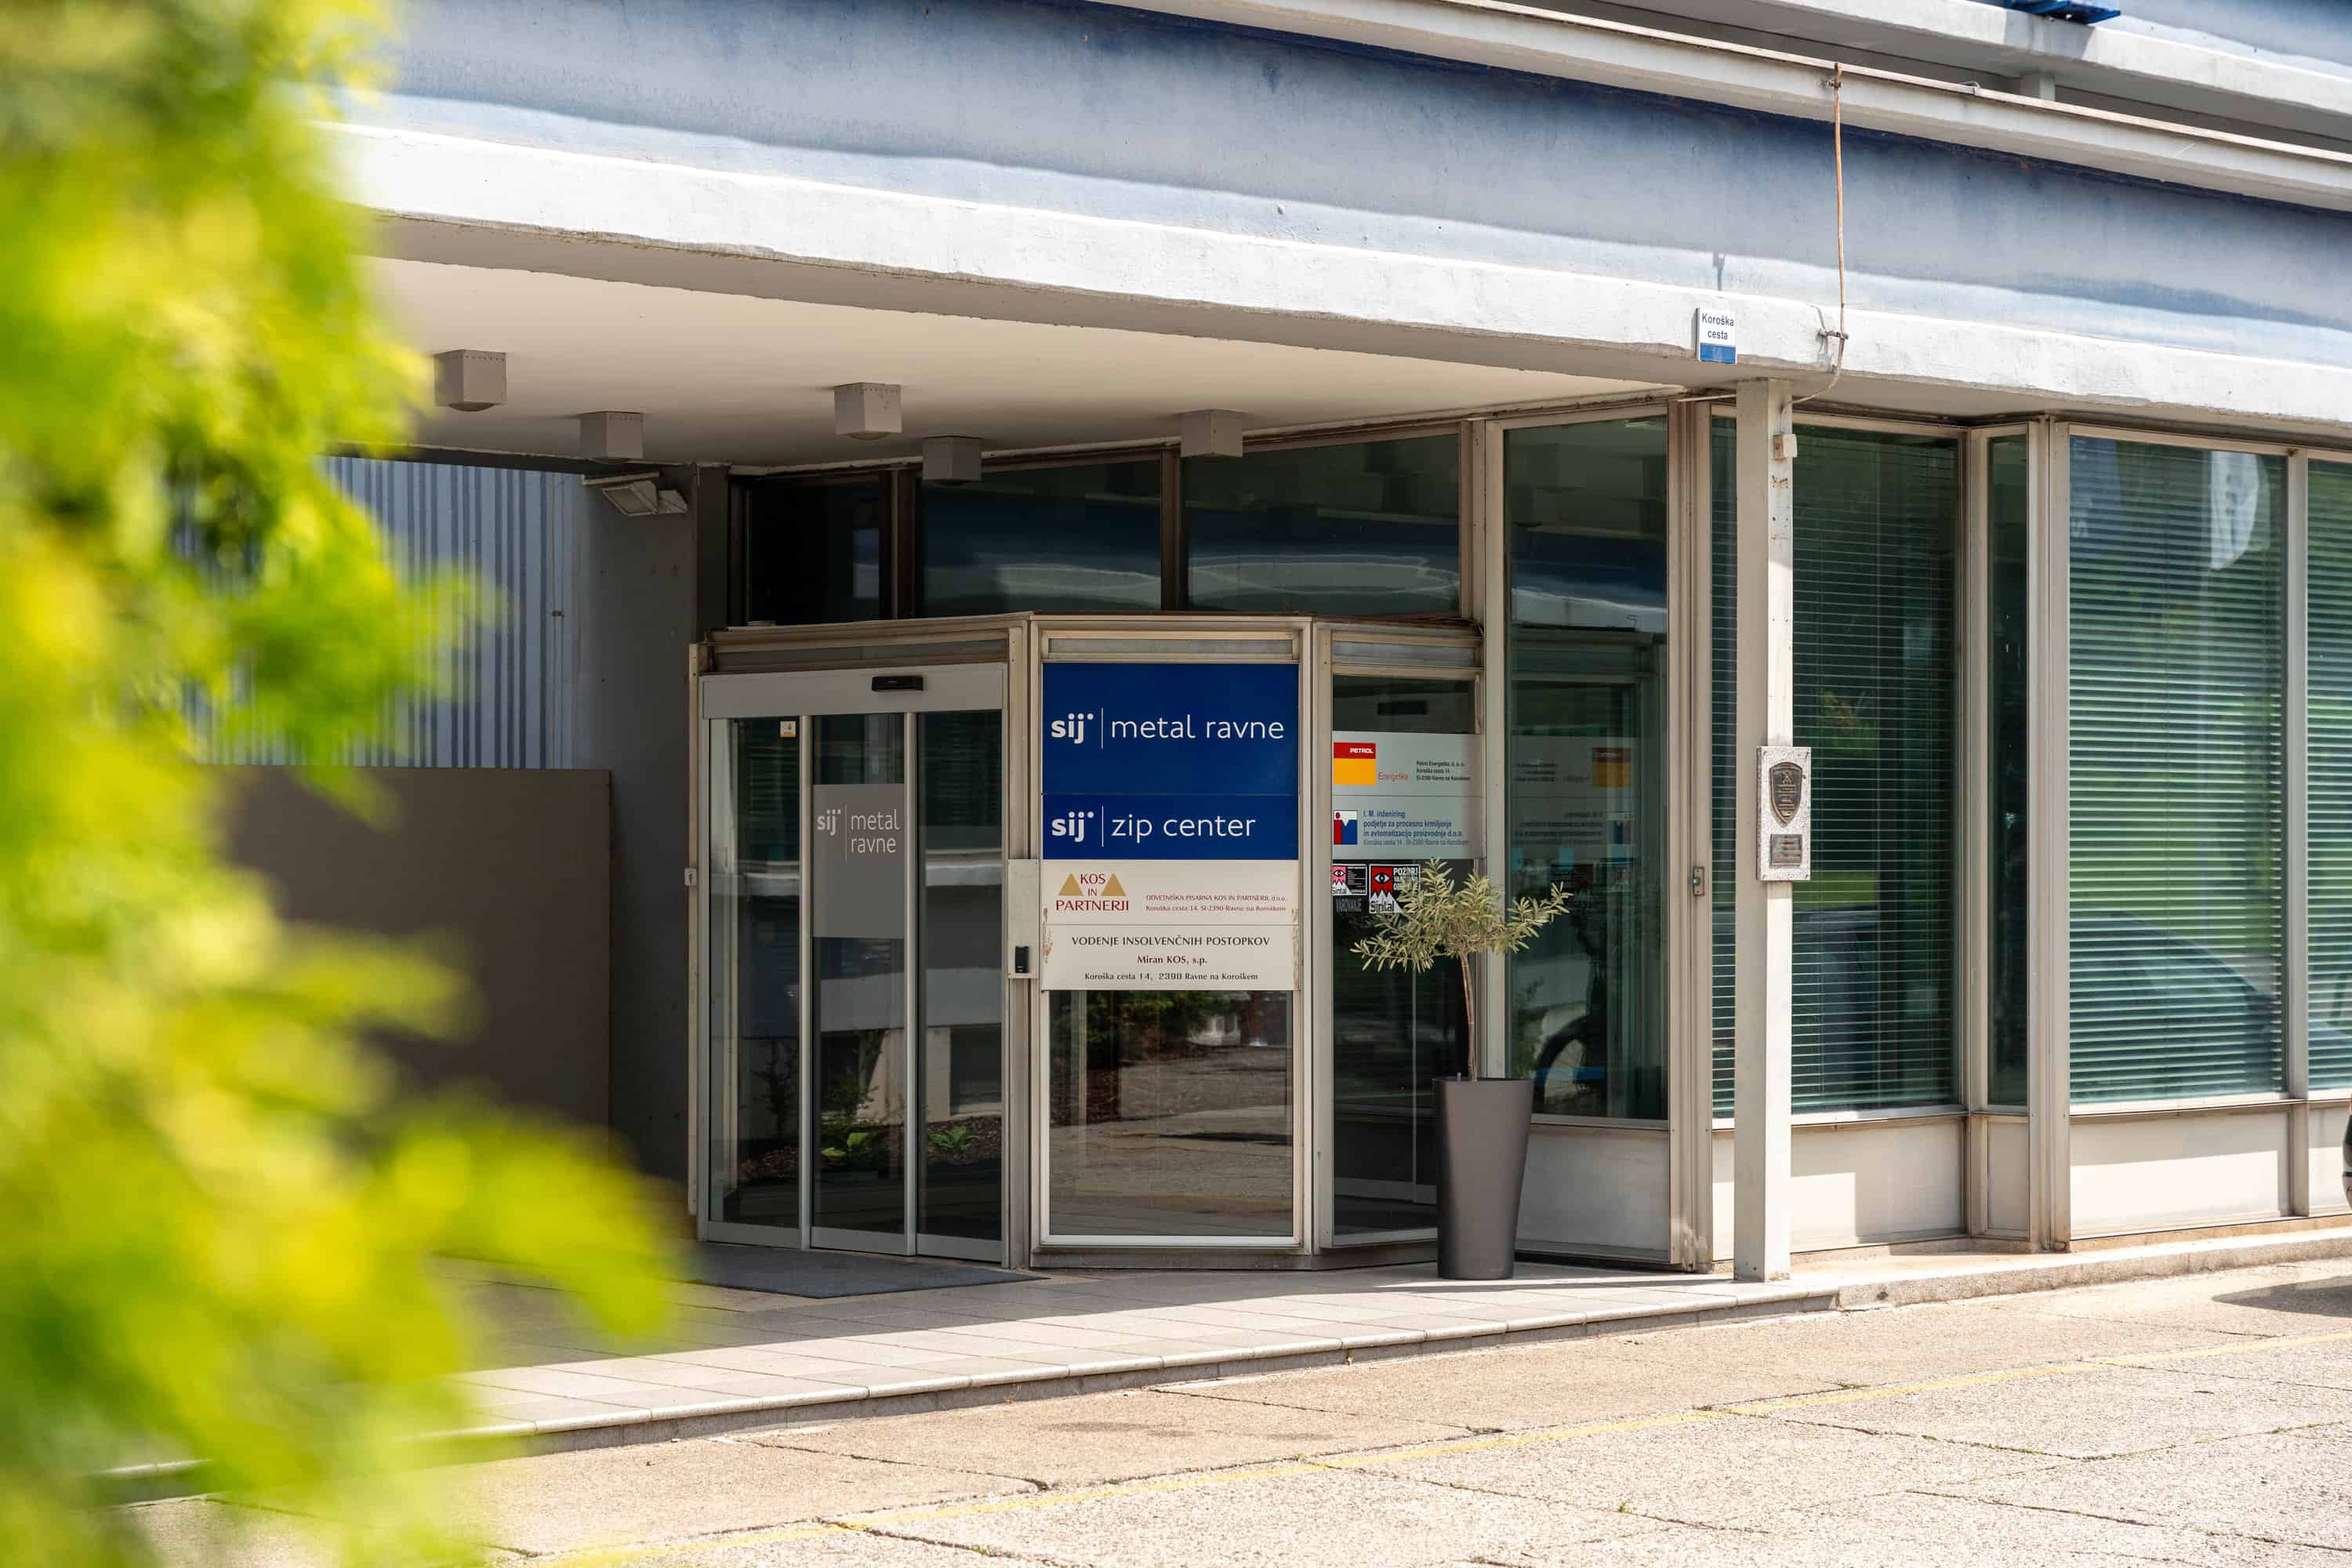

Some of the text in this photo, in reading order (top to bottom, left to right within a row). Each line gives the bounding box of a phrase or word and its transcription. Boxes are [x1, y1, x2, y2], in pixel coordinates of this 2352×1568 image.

[1702, 314, 1734, 326] Koroška
[1708, 330, 1728, 340] cesta
[1051, 713, 1284, 744] sij metal ravne
[1378, 772, 1409, 782] Energetika
[1377, 810, 1405, 818] inženiring
[817, 808, 901, 836] sij metal
[1051, 811, 1256, 844] sij zip center
[1363, 820, 1387, 829] podjetje
[1424, 820, 1452, 829] krmiljenje
[851, 837, 896, 854] ravne
[1080, 873, 1106, 884] KOS
[1055, 900, 1129, 911] PARTNERJI
[1370, 900, 1395, 913] Sintal
[1072, 935, 1270, 946] VODENJE INSOLVENČNIH POSTOPKOV
[1137, 955, 1208, 966] Miran KOS, s.p.
